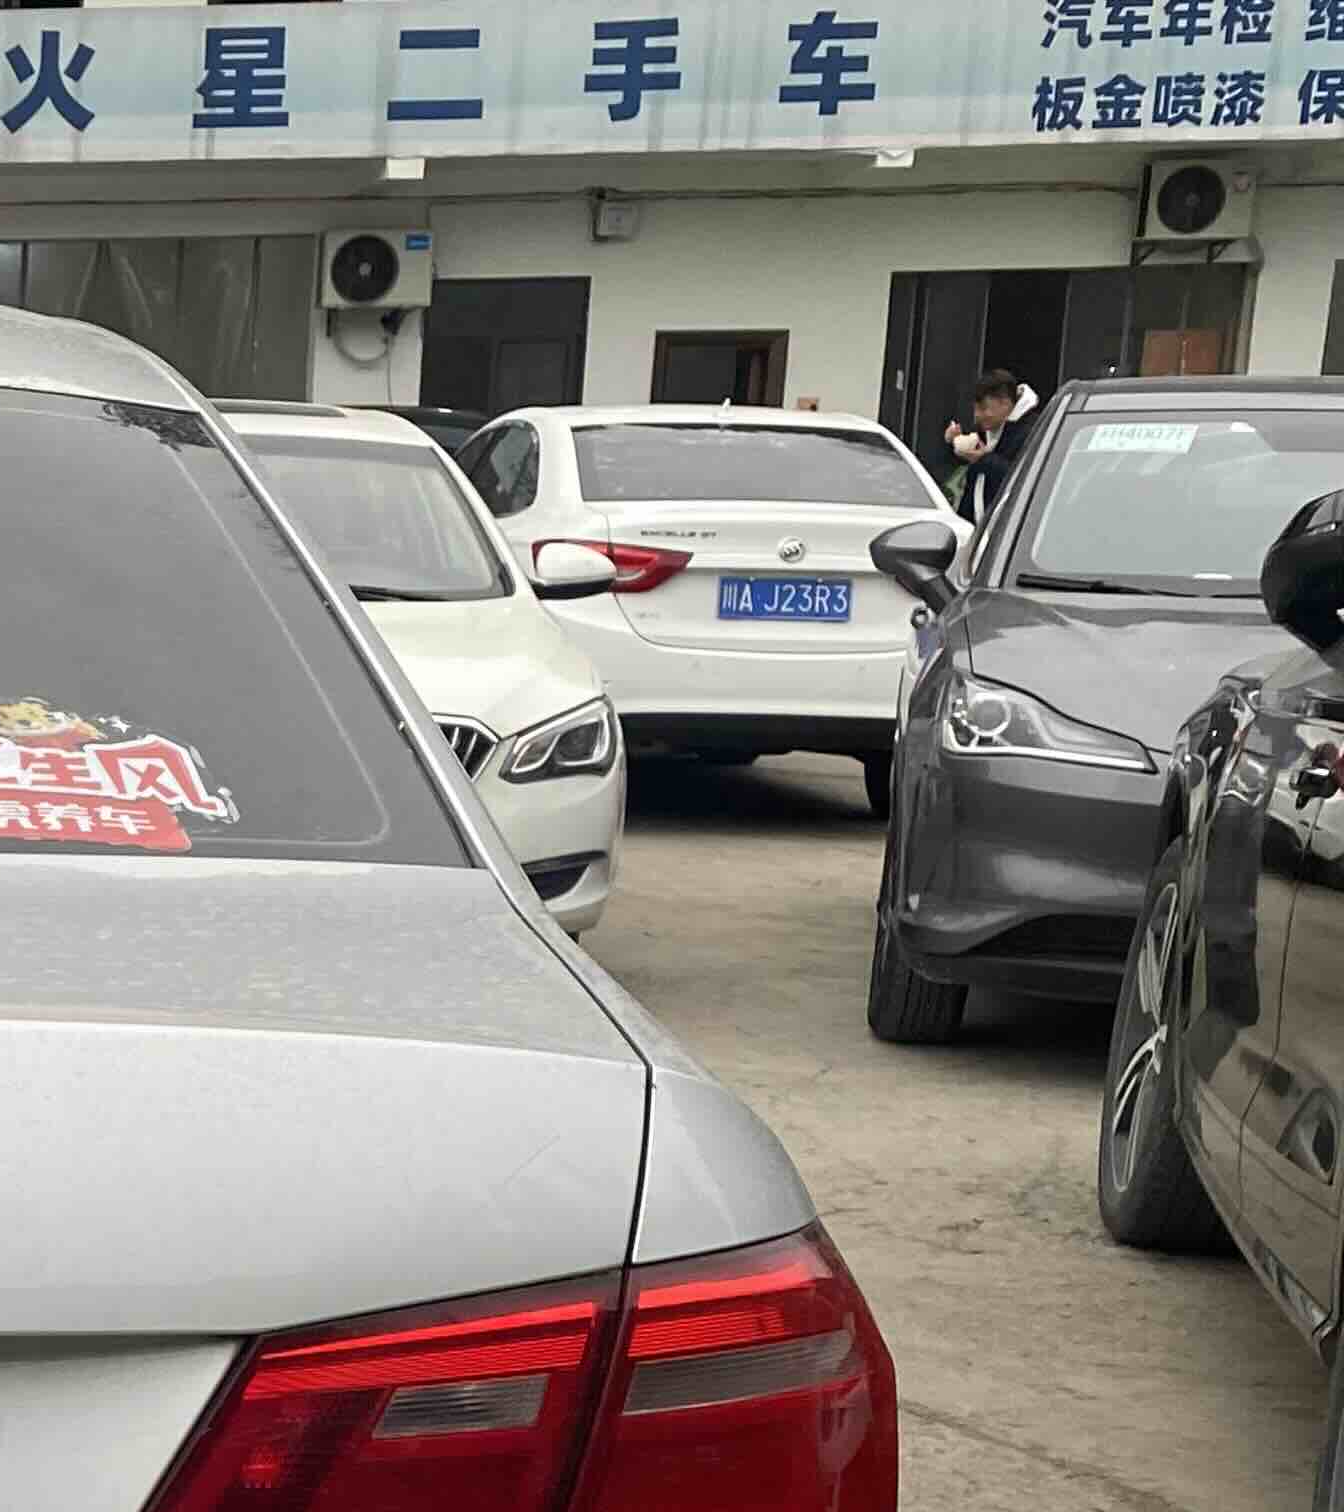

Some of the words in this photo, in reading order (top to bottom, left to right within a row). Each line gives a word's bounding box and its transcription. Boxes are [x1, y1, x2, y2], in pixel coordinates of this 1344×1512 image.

[1040, 0, 1274, 49] 汽车年检
[0, 10, 880, 134] 火星二手车
[1031, 69, 1266, 133] 板金喷漆
